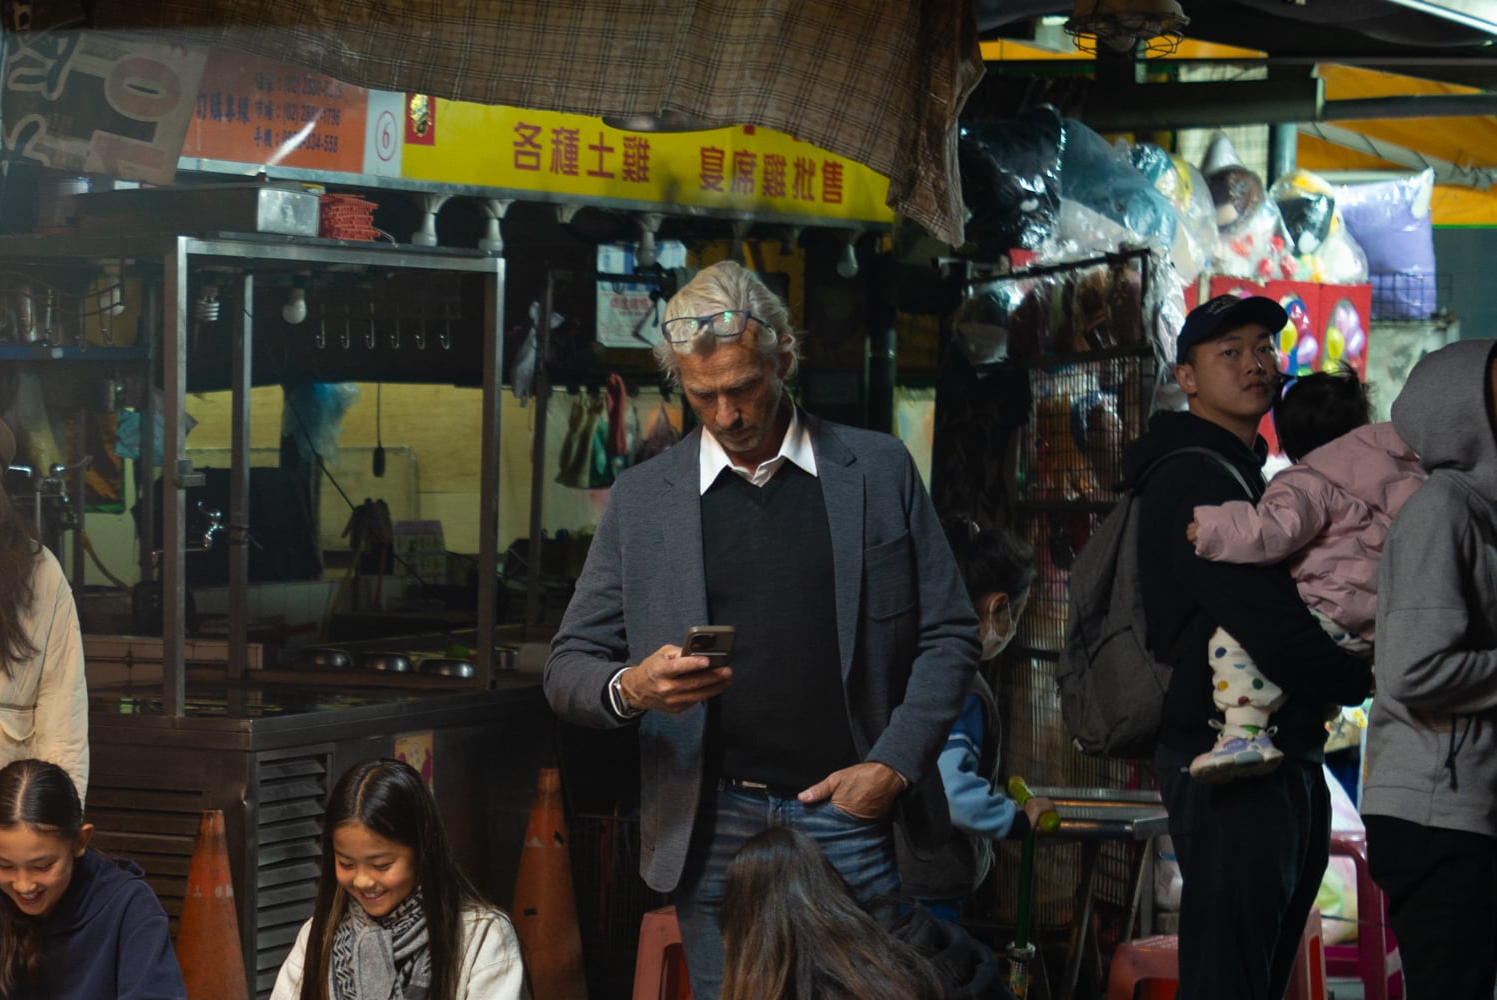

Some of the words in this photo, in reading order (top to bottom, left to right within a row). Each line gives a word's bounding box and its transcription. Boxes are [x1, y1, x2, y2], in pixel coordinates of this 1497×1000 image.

[513, 121, 651, 184] 各種土雞
[699, 144, 845, 204] 宴席雞批售
